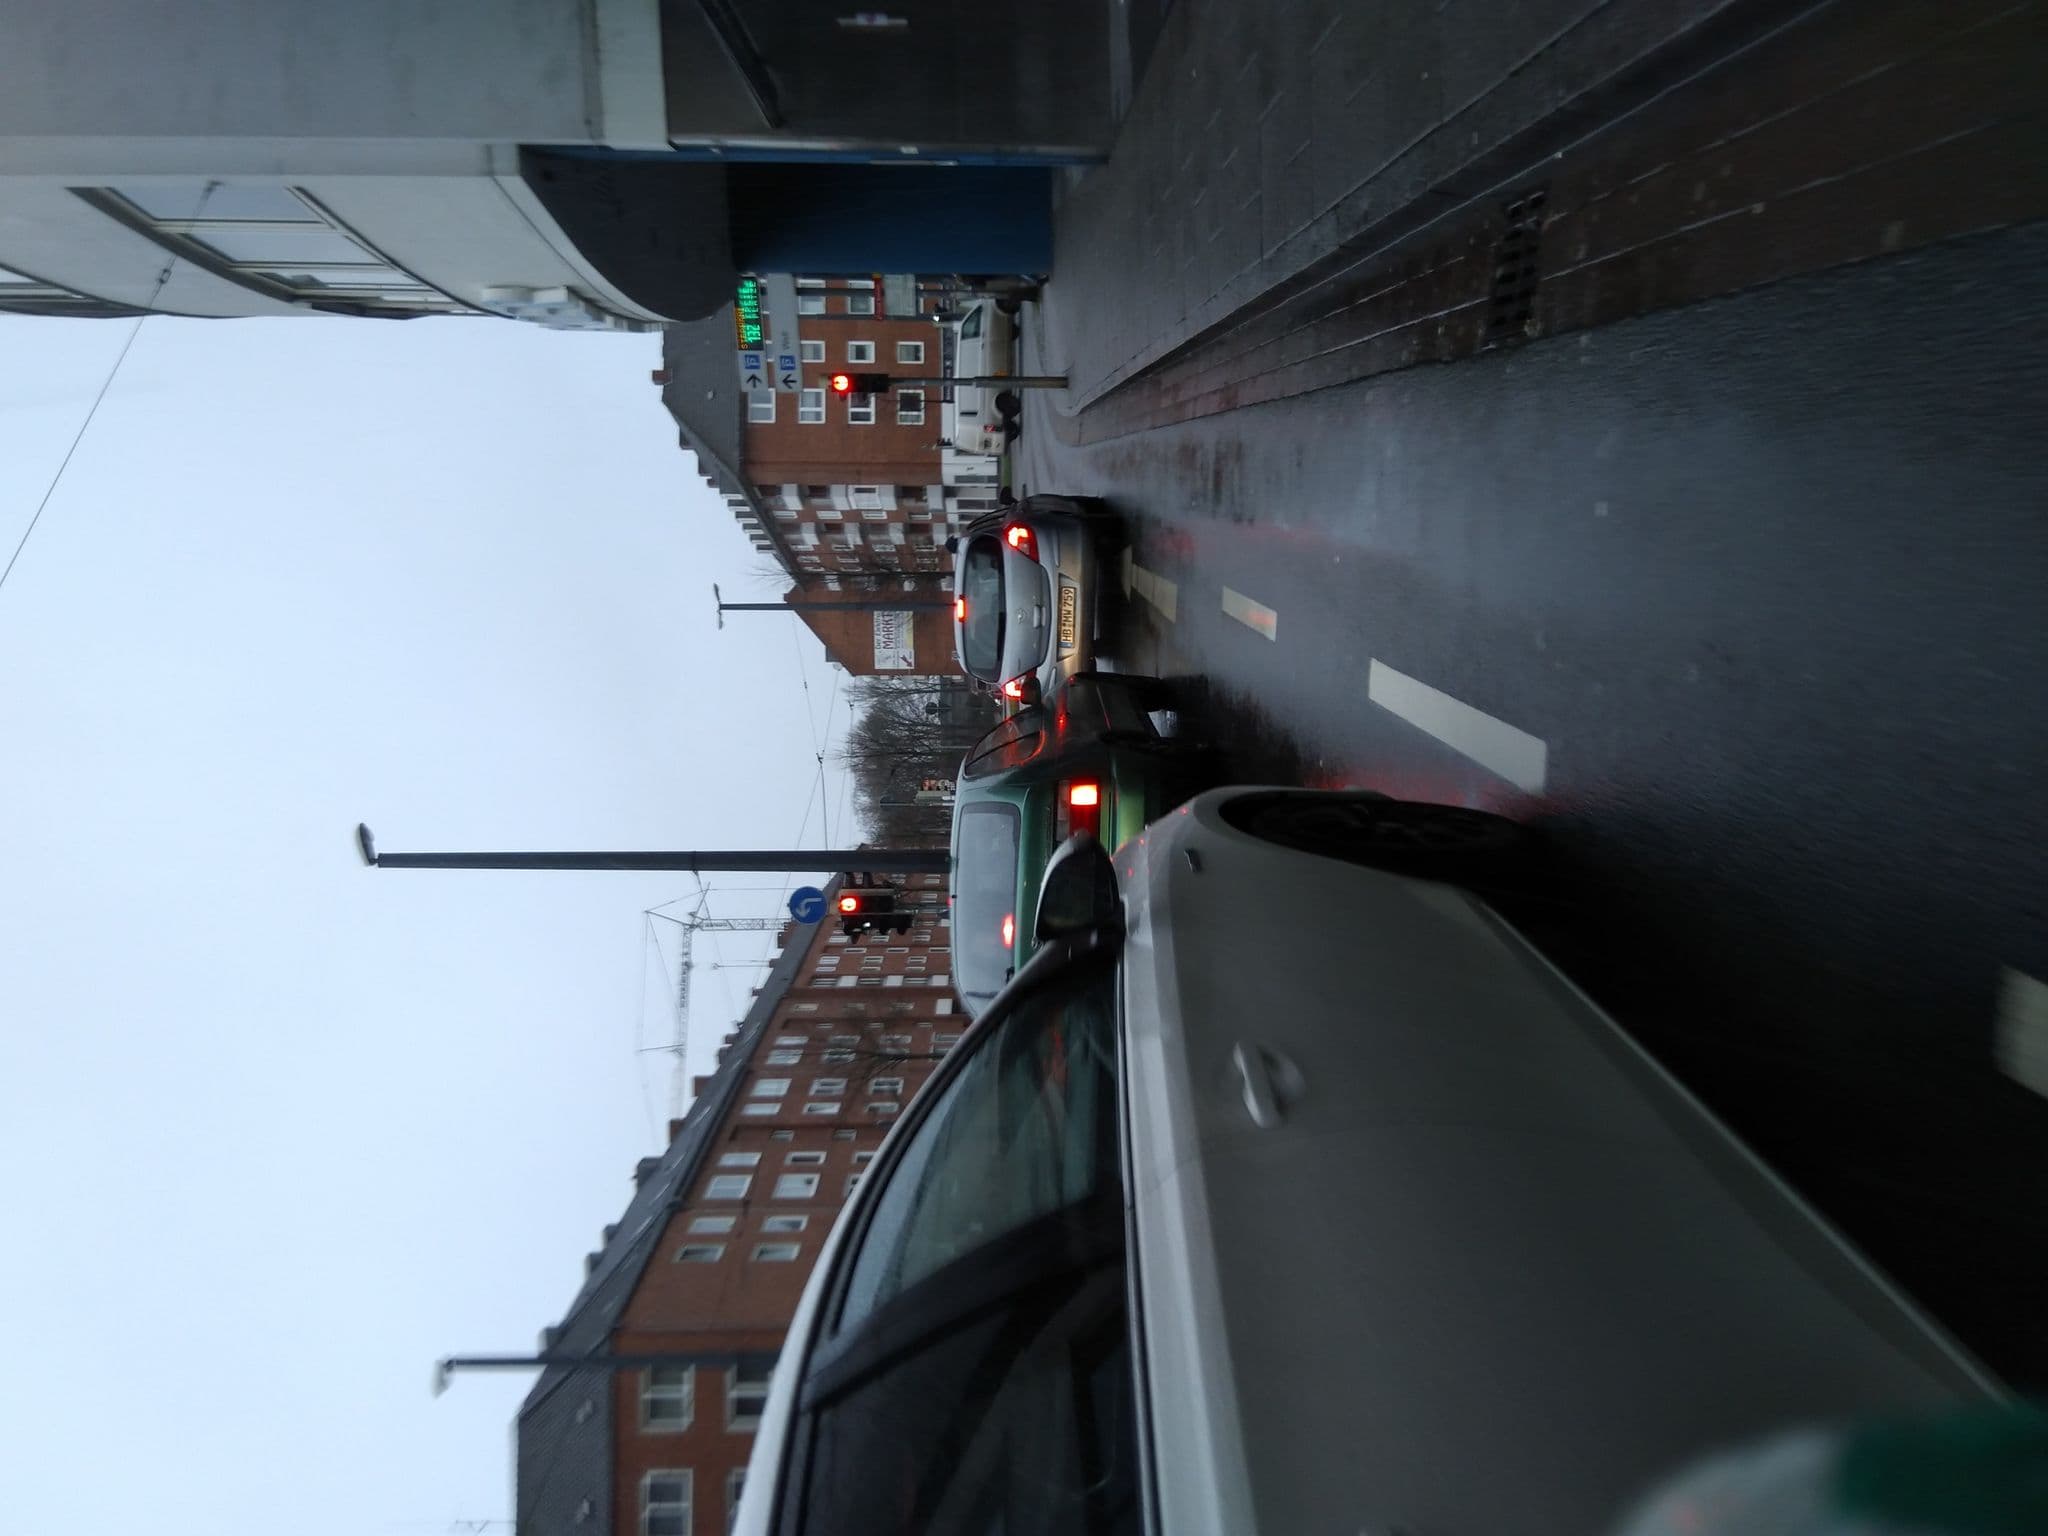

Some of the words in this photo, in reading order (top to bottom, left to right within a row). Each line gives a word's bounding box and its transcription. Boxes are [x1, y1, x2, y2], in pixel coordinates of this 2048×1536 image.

[746, 324, 761, 342] 132
[1063, 589, 1073, 607] 759
[1062, 609, 1072, 622] MW
[882, 614, 894, 649] MARKT
[1062, 629, 1072, 641] HB
